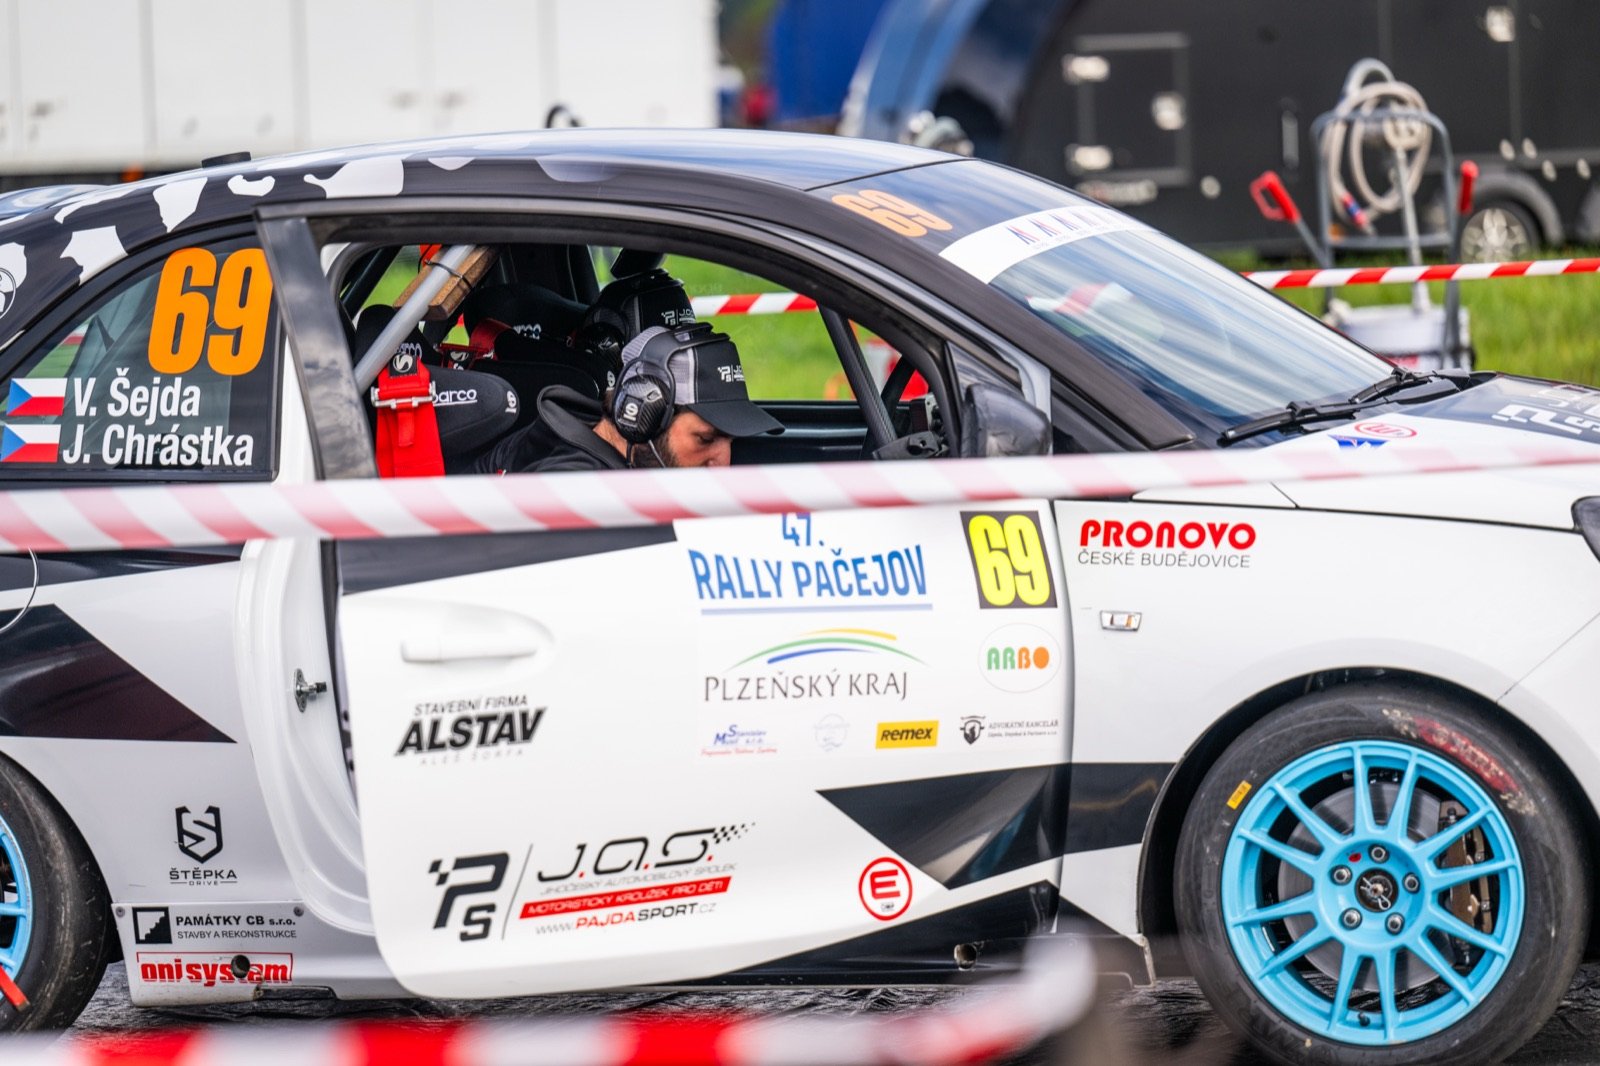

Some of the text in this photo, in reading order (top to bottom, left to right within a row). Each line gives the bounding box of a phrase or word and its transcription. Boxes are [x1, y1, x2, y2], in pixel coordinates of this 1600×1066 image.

[148, 247, 273, 376] 69
[74, 367, 201, 426] V. Šejda
[63, 423, 254, 466] J. Chrástka
[1080, 519, 1257, 550] PRONOVO
[688, 544, 927, 600] RALLY PAČEJOV
[968, 514, 1051, 607] 69
[1077, 548, 1251, 569] ČESKÉ BUDĚJOVICE
[987, 646, 1050, 671] ARBO
[704, 668, 908, 702] PLZEŇSKÝ KRAJ
[414, 694, 528, 717] STAVEBNÍ FIRMA
[394, 706, 548, 757] ALSTAV
[169, 867, 238, 880] ŠTĚPKA
[672, 883, 697, 896] PRO
[698, 879, 724, 893] DĚTI
[175, 914, 296, 926] PAMÁTKY CB s.r.o.
[177, 929, 297, 940] STAVBY A REKONSTRUKCE
